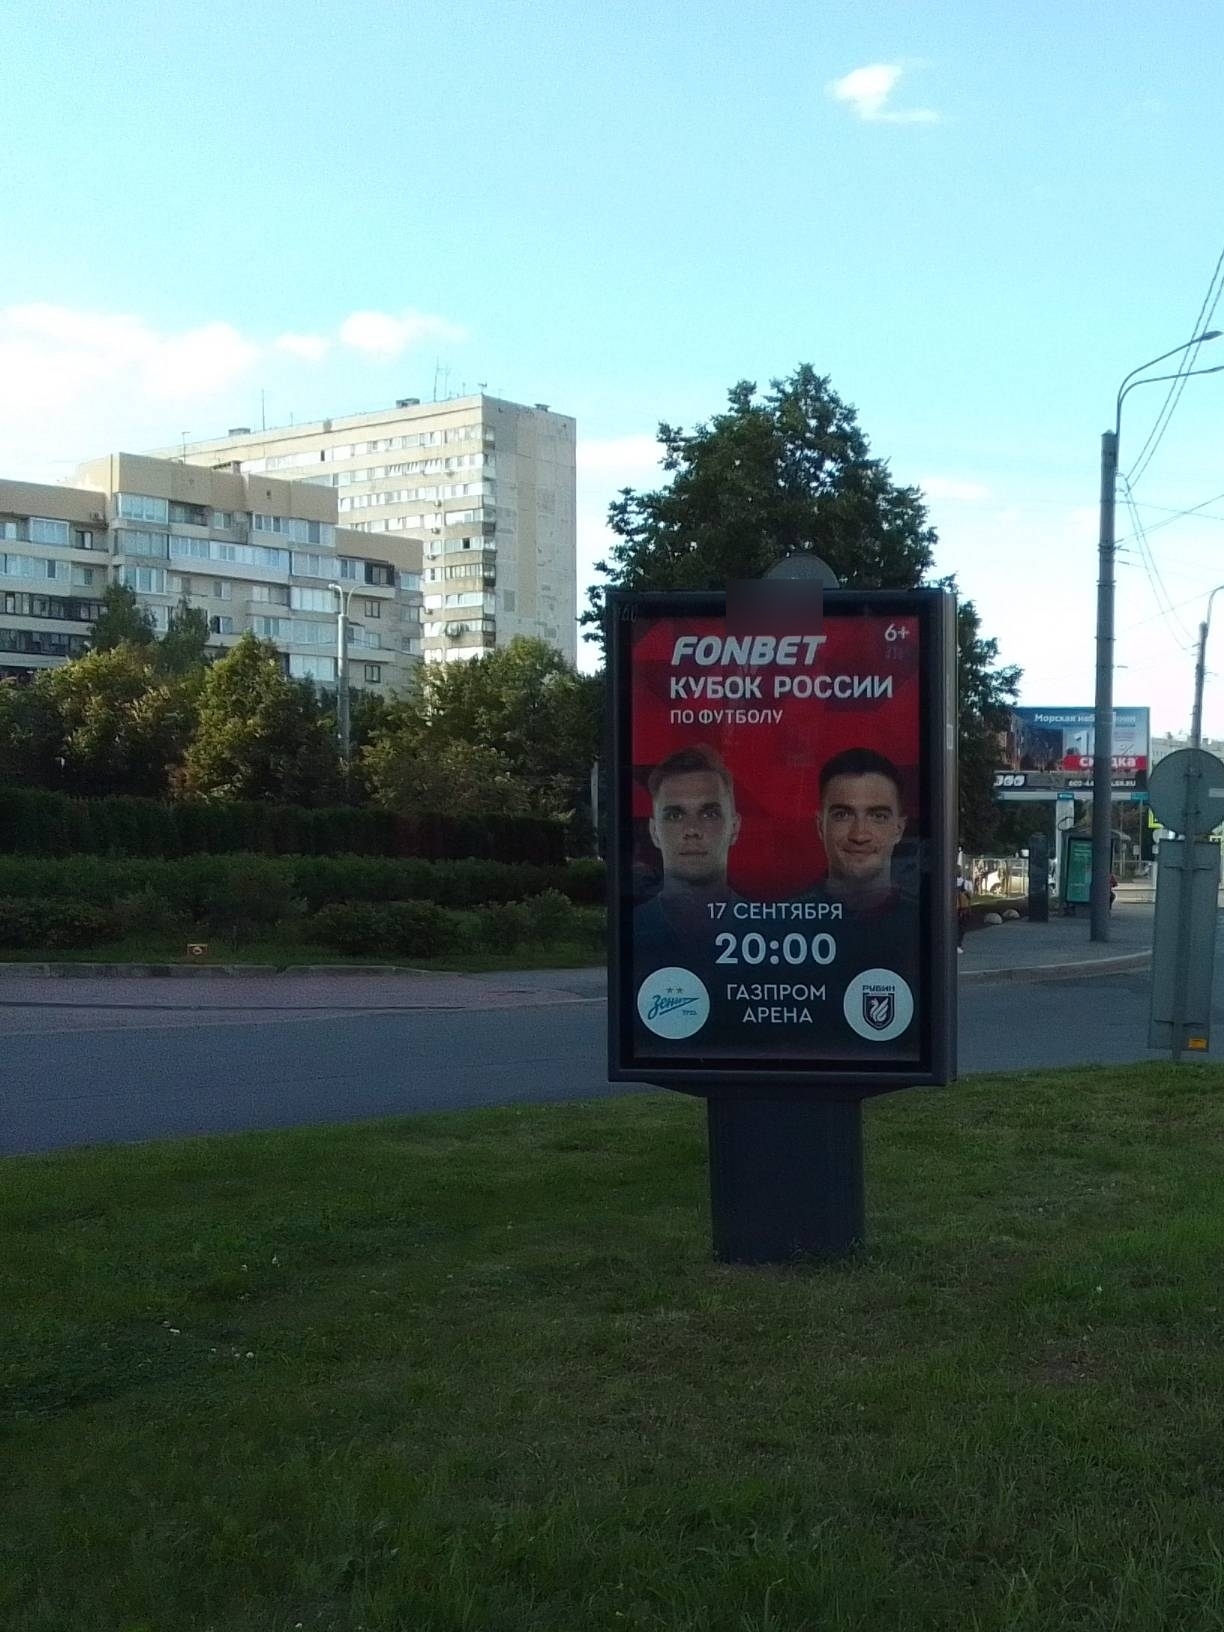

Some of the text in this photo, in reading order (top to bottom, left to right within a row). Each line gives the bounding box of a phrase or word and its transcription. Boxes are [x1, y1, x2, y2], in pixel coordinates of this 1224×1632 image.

[884, 623, 910, 642] 6+
[671, 635, 827, 666] FONBET
[670, 675, 894, 699] КУБОК РОССИИ
[670, 708, 784, 724] ПО ФУТБОЛУ
[1034, 713, 1077, 724] Морская
[707, 902, 843, 920] 17 СЕНТЯБРЯ
[714, 932, 837, 966] 20:00
[726, 984, 826, 1001] ГАЗПРОМ
[742, 1006, 814, 1024] АРЕНА
